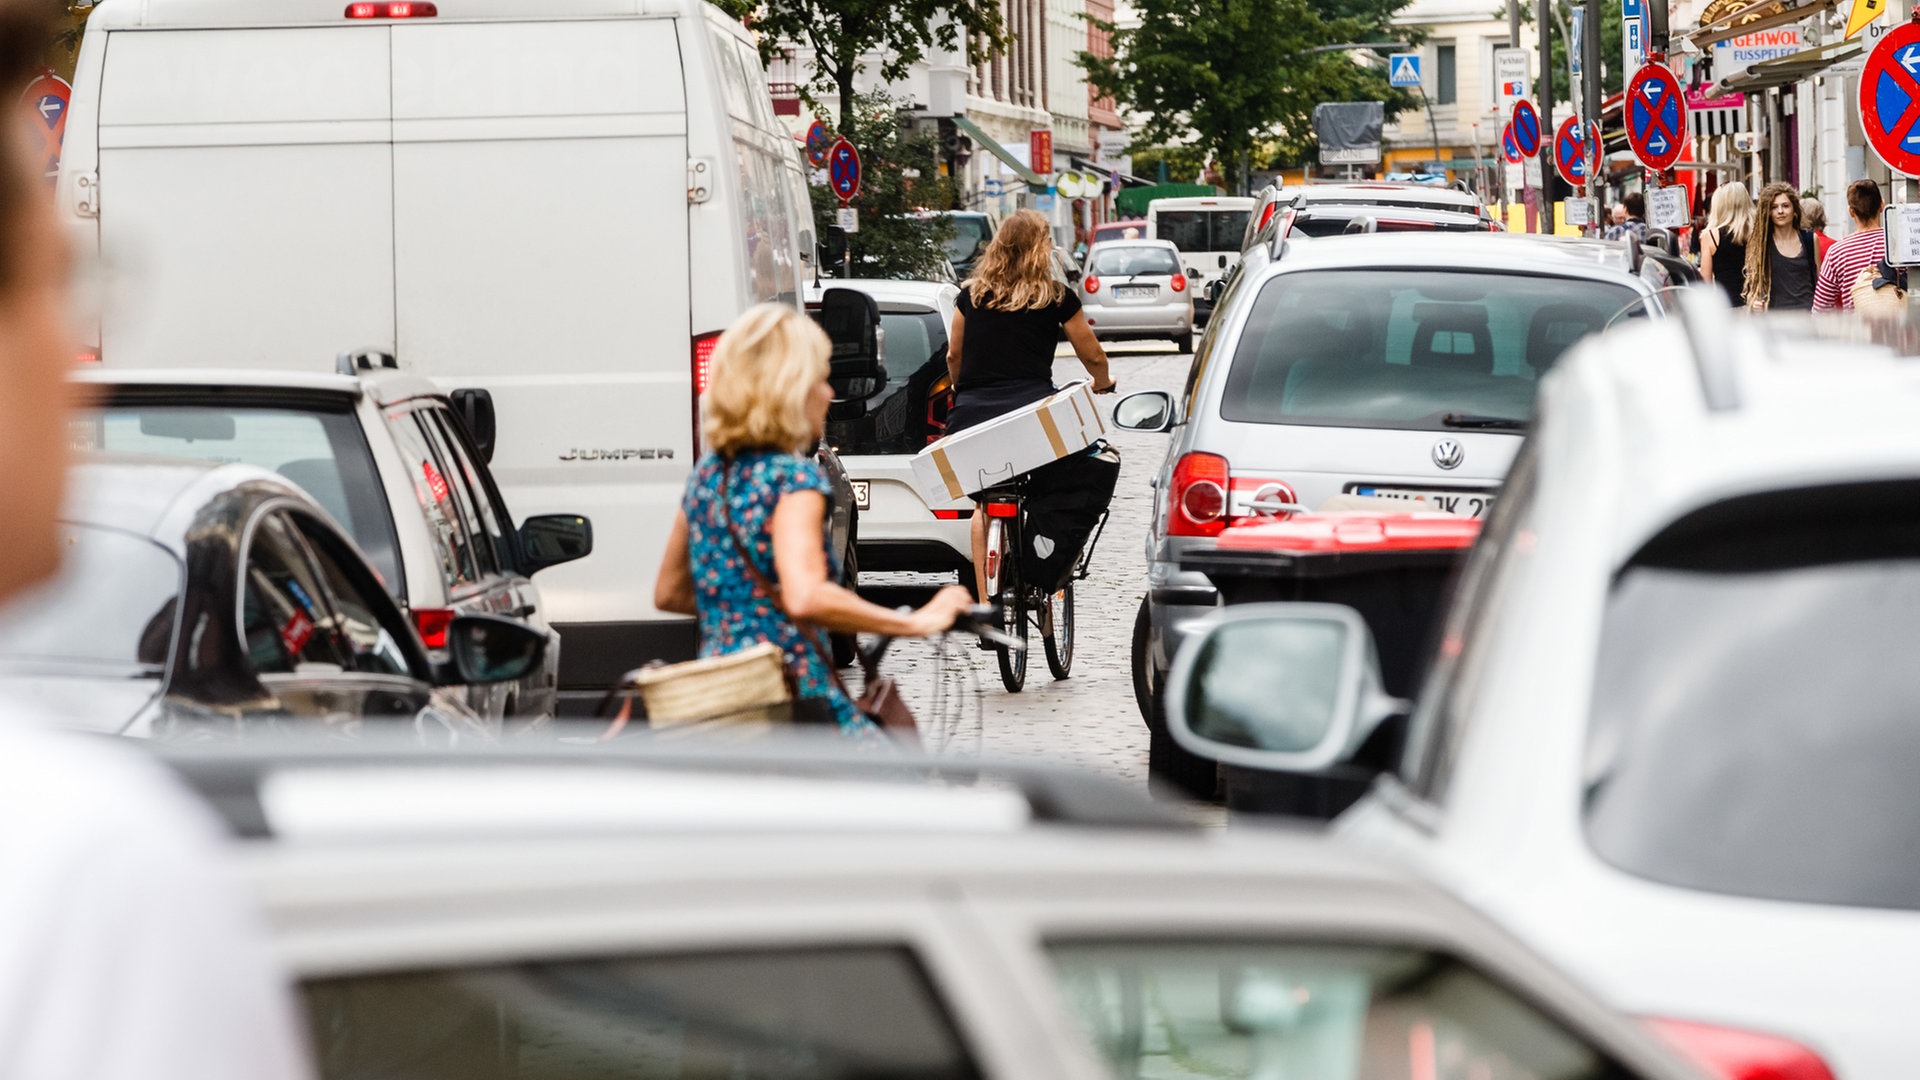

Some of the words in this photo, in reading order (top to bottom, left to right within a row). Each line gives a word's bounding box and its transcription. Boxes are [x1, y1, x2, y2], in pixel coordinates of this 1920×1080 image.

[1734, 30, 1800, 47] GEHWOL
[559, 448, 674, 461] JUMPER
[852, 484, 867, 502] 3
[1469, 498, 1496, 519] 2
